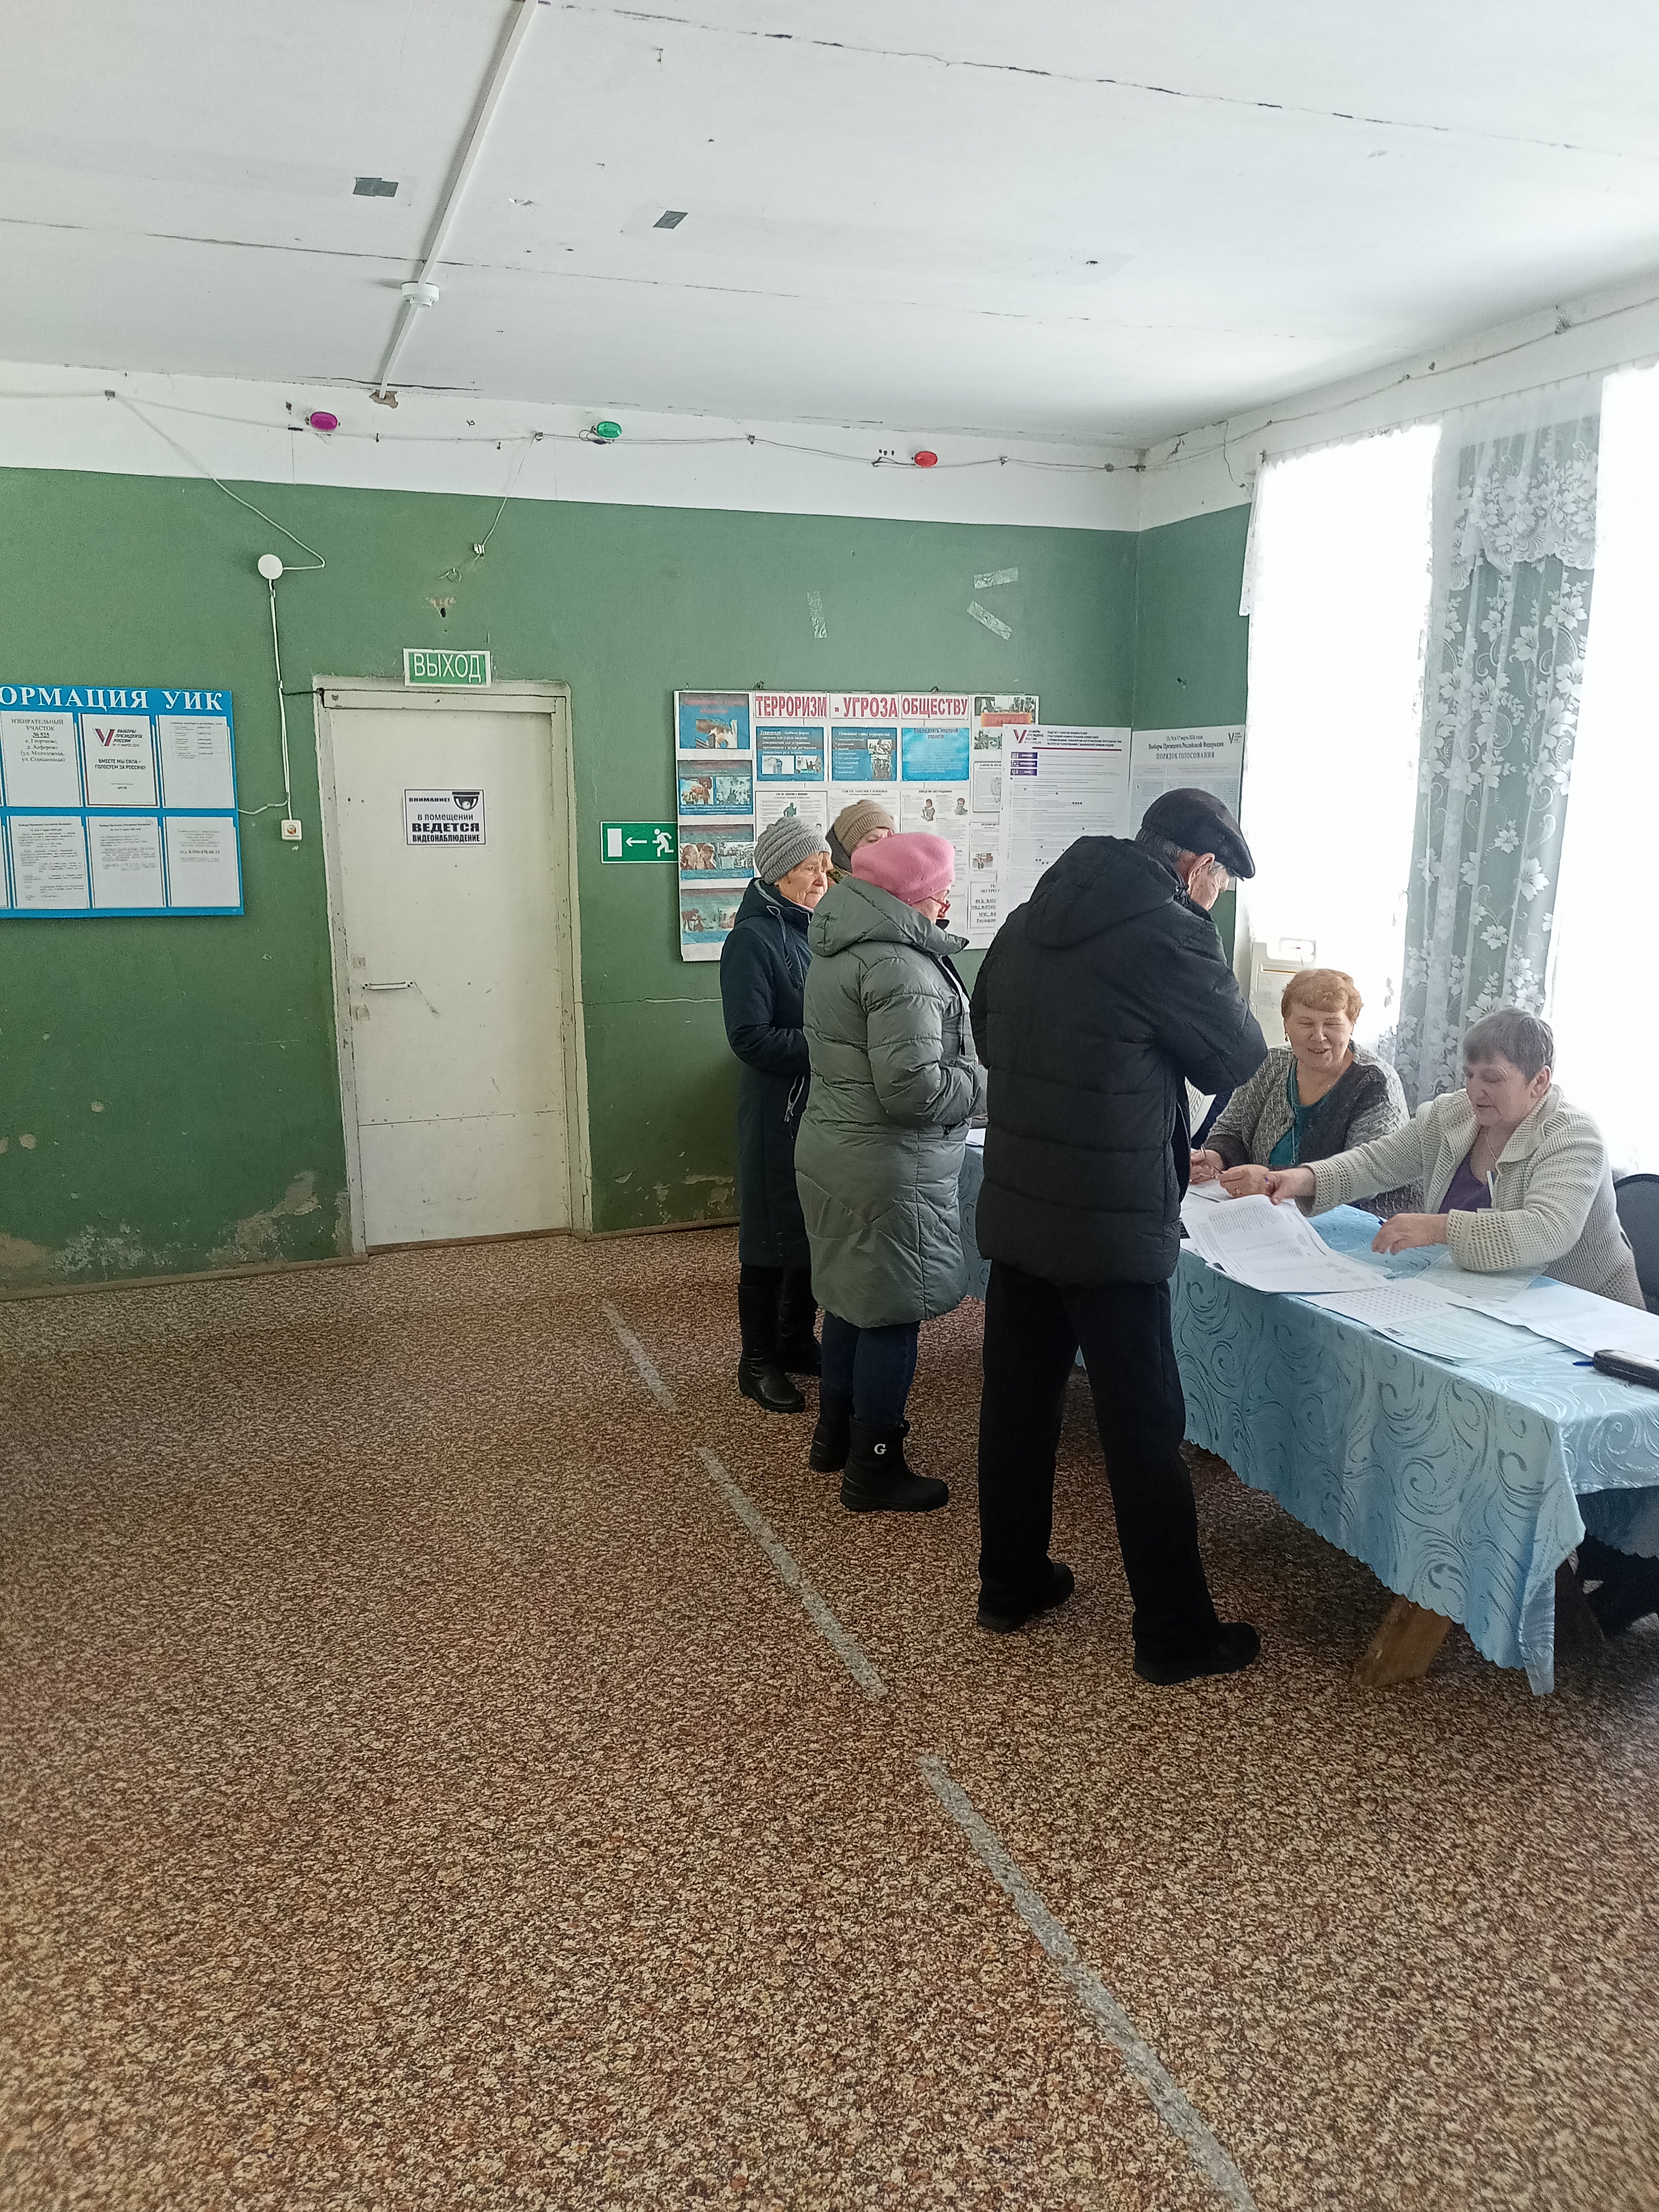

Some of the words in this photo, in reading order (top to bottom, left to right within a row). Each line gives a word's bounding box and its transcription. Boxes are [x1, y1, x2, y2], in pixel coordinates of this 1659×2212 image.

[414, 653, 481, 683] ВЫХОД
[0, 686, 149, 712] ОРМАЦИЯ
[161, 691, 223, 711] УИК
[755, 696, 827, 717] ТЕРРОРИЗМ
[843, 697, 898, 718] УГРОЗА
[902, 697, 968, 718] ОБЩЕСТВУ
[1178, 751, 1215, 759] ГОЛОСОВАНИЯ
[411, 822, 480, 834] ВЕДЕТСЯ
[412, 834, 481, 843] ВИДЕОНАБЛЮДЕНИЕ
[874, 1443, 887, 1455] G
